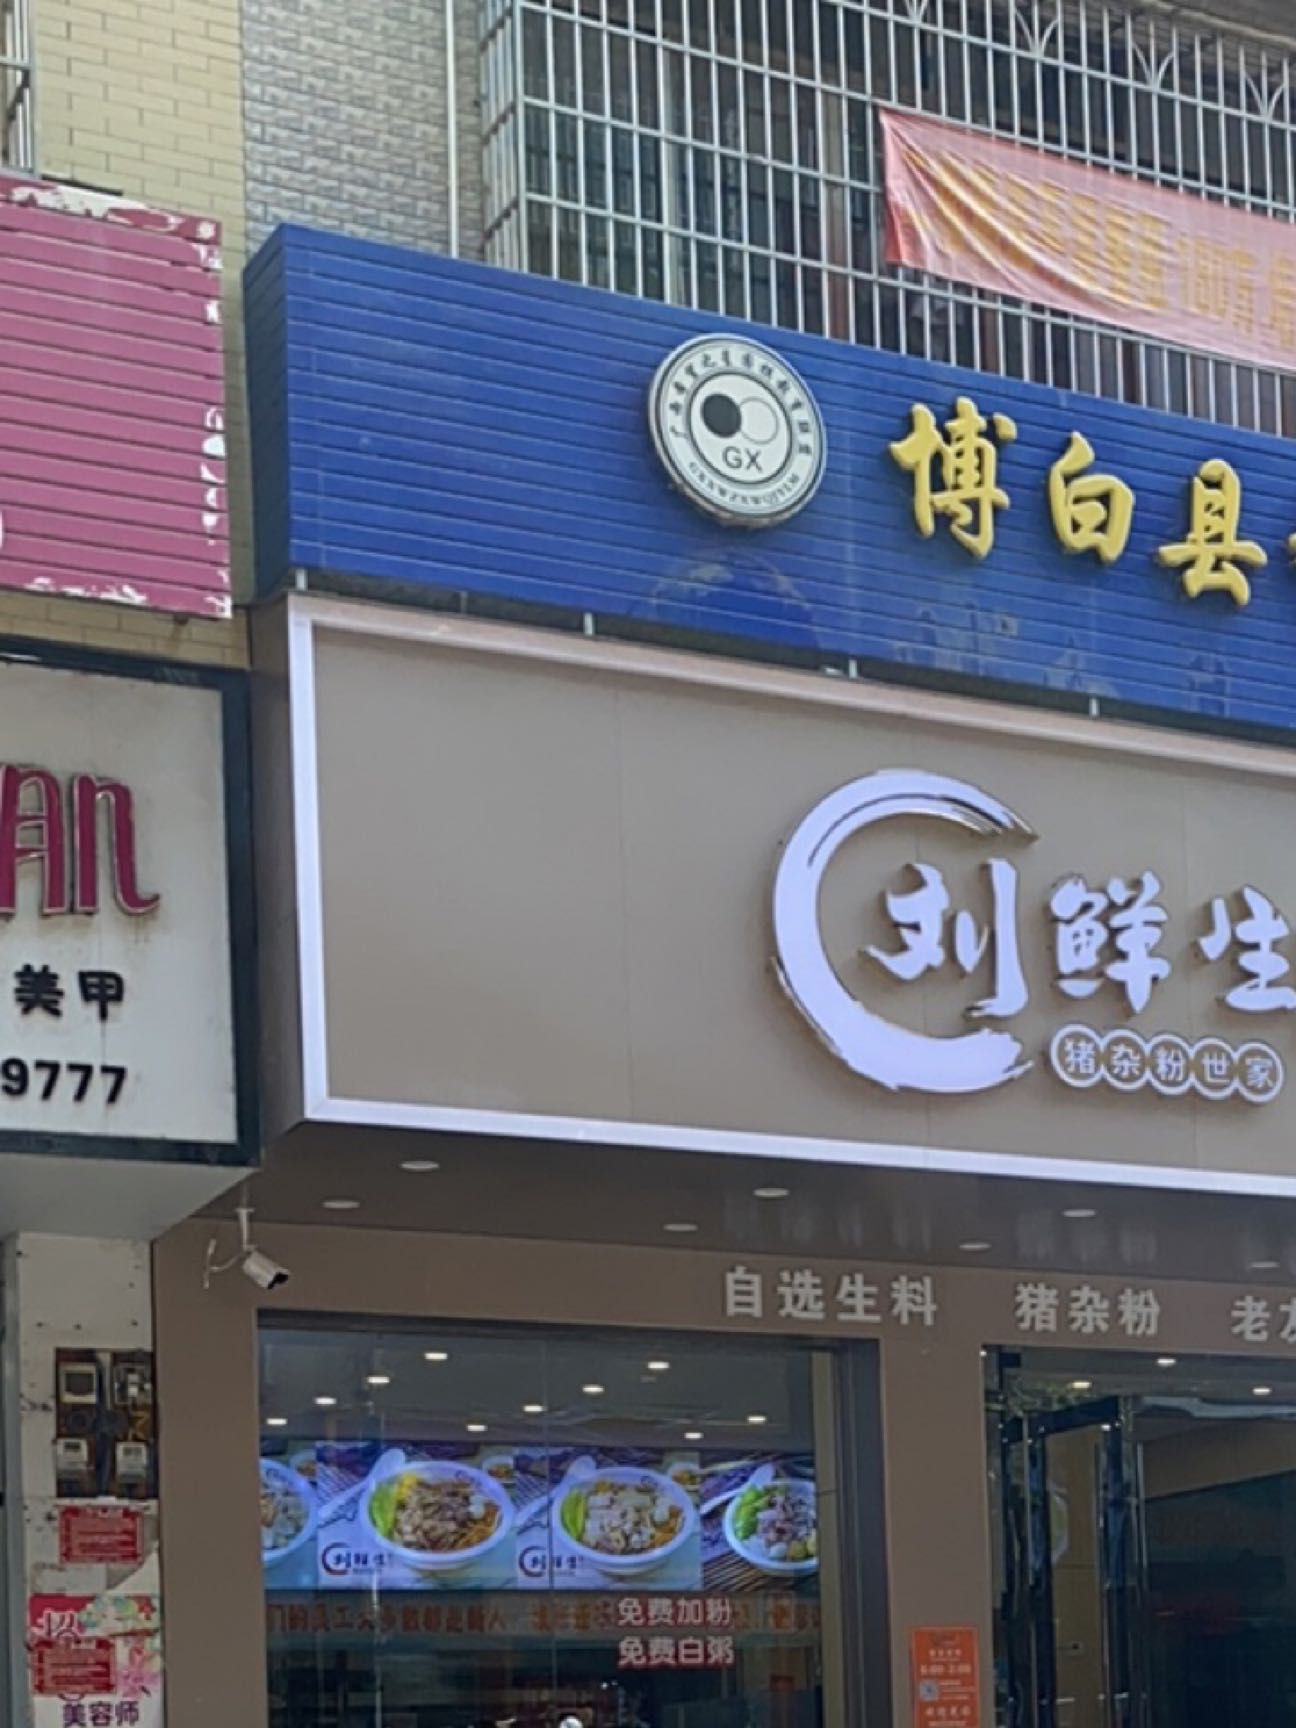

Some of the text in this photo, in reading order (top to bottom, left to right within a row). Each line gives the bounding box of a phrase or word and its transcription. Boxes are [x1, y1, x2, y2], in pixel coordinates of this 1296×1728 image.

[722, 446, 763, 472] GX
[14, 964, 125, 1021] 美甲
[0, 1057, 127, 1104] 9777
[1063, 1035, 1278, 1090] 猪杂粉世家
[723, 1265, 938, 1327] 自选生料
[1014, 1283, 1160, 1336] 猪杂粉
[617, 1597, 732, 1627] 免费加粉
[617, 1635, 734, 1665] 免费白粥
[62, 1701, 140, 1728] 美容师
